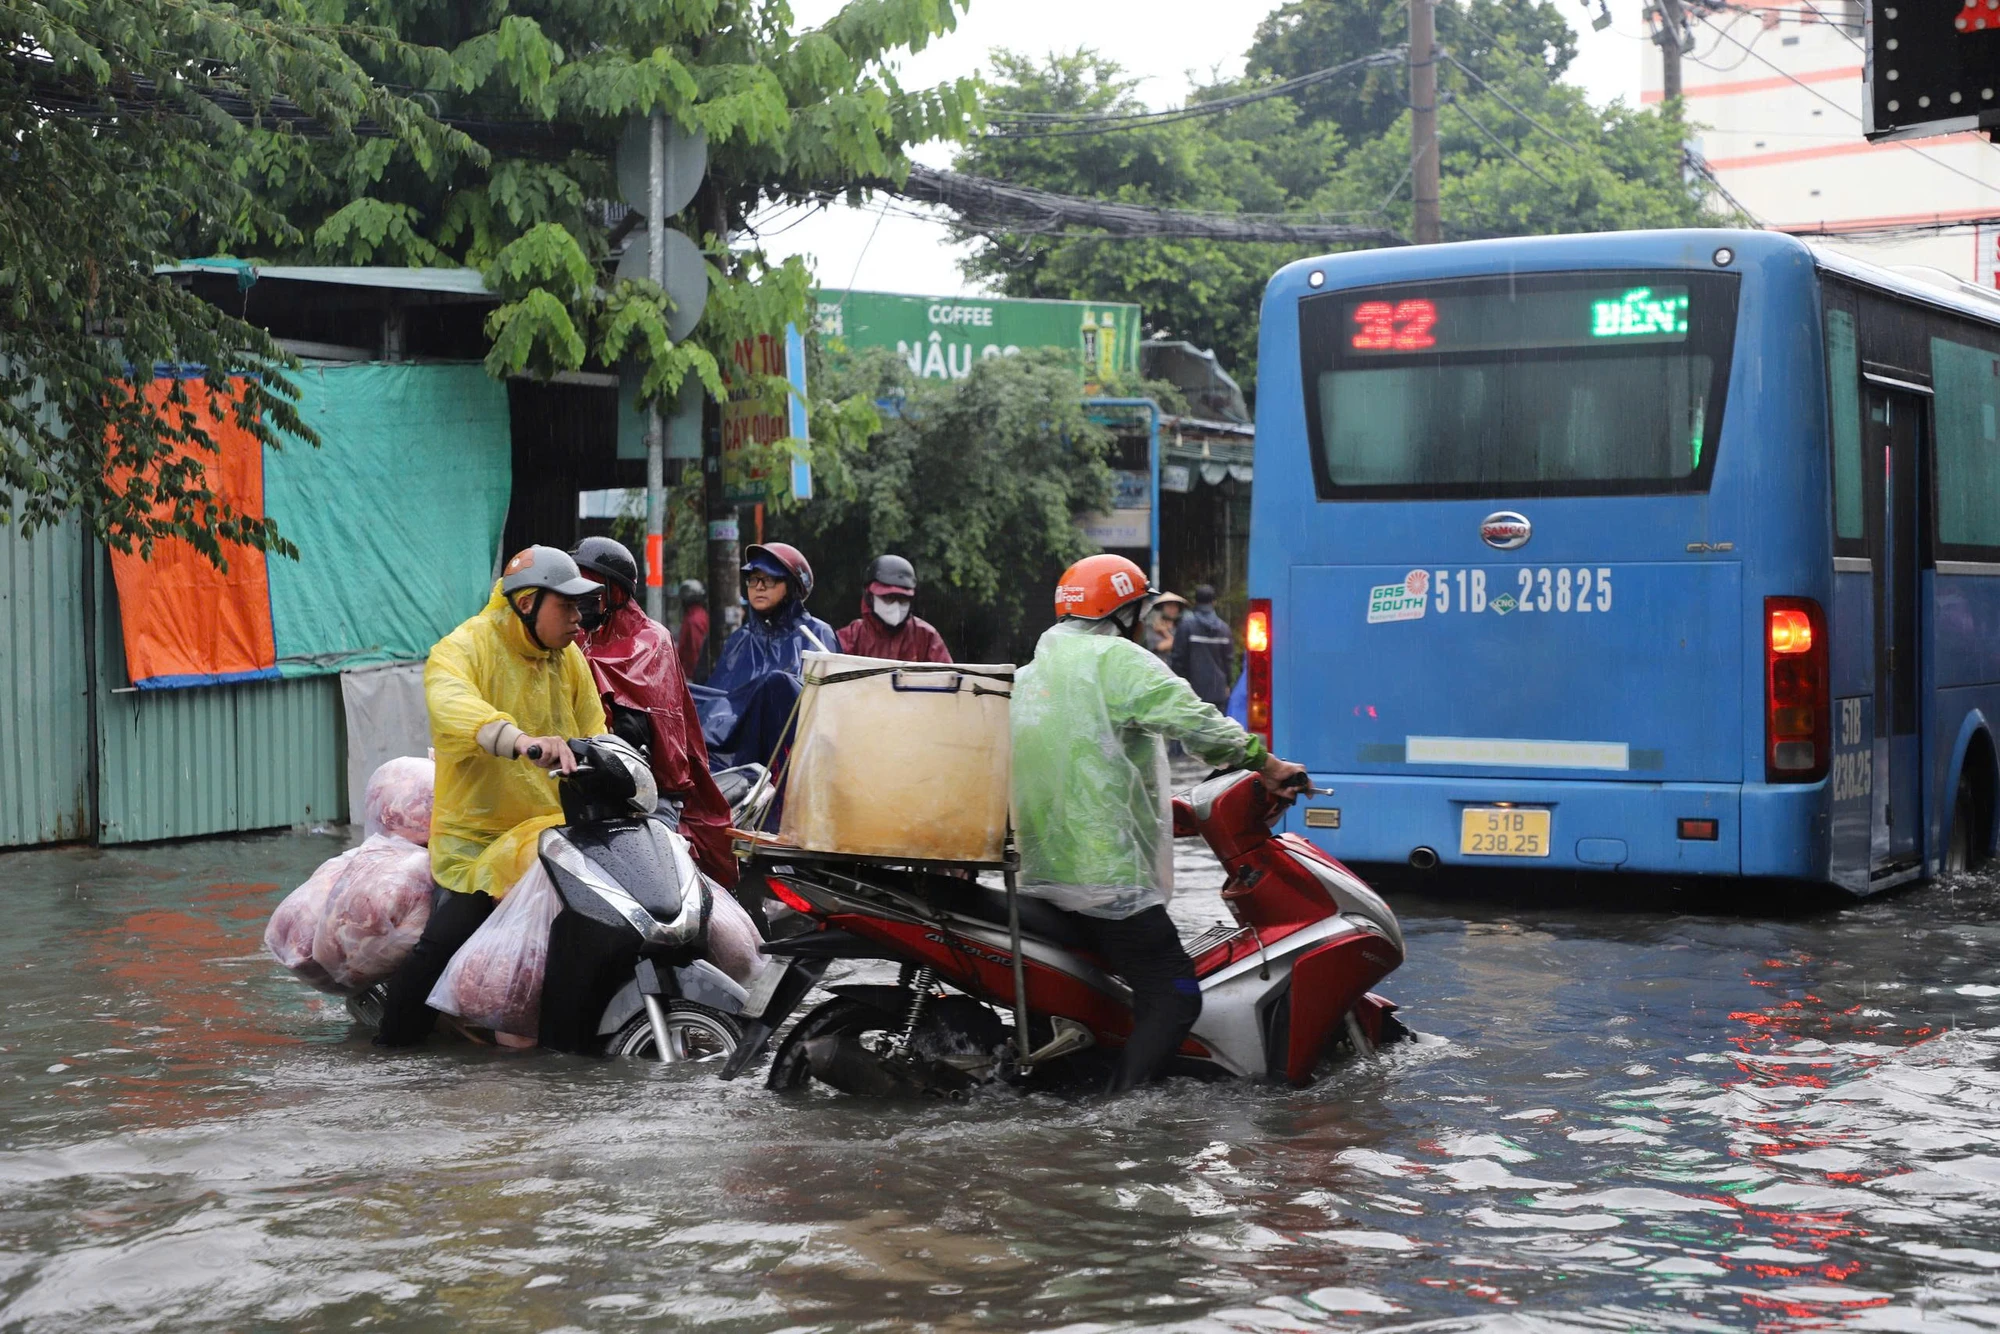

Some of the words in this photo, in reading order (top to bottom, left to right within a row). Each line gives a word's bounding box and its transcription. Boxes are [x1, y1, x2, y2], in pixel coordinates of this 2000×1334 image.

[928, 304, 993, 326] COFFEE
[1352, 299, 1436, 349] 32
[897, 330, 972, 379] NÂU
[1483, 526, 1526, 536] SAMCO
[1062, 592, 1084, 602] Food
[1373, 586, 1405, 599] GAS
[1434, 570, 1487, 613] 51B
[1518, 568, 1612, 612] 23825
[1371, 598, 1424, 612] SOUTH
[1842, 698, 1861, 745] 51B
[1488, 813, 1524, 831] 51B
[1471, 834, 1539, 852] 238.25
